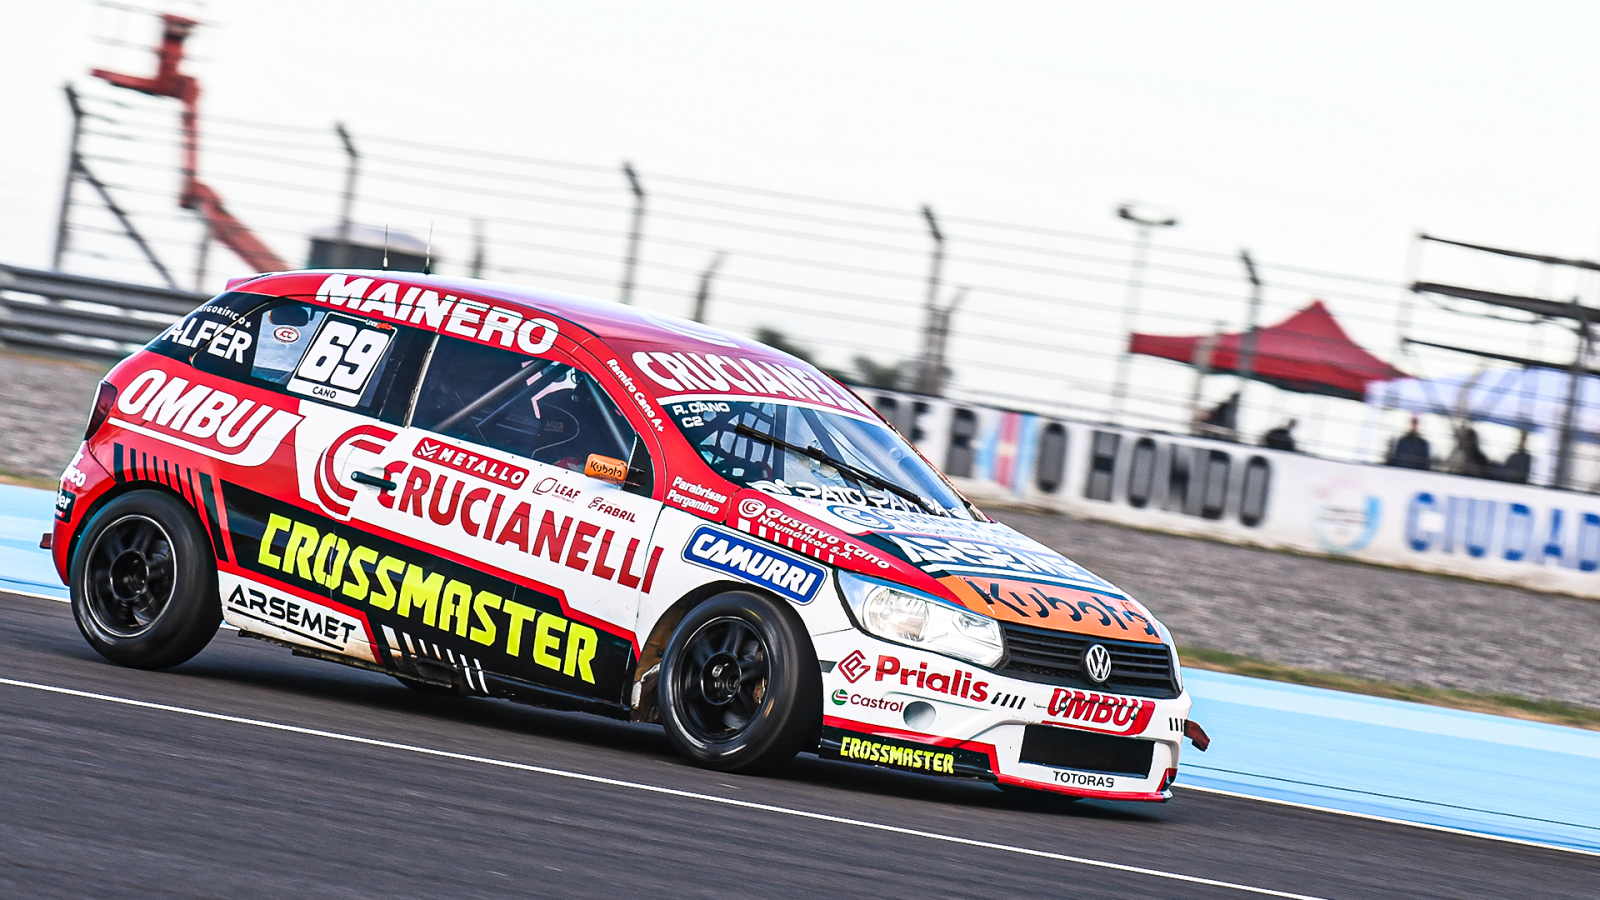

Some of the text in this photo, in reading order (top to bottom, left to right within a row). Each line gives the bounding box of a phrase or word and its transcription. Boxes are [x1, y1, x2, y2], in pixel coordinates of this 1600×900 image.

[314, 273, 560, 355] MAINERO
[161, 317, 253, 363] ALFER
[297, 319, 391, 391] 69
[117, 369, 273, 448] OMBU
[312, 386, 338, 399] CANO
[606, 358, 637, 393] Ramiro
[634, 391, 656, 418] Cano
[688, 402, 731, 413] CANO
[681, 416, 705, 428] C2
[438, 446, 526, 485] METALLO
[590, 461, 623, 477] Kubota
[1084, 429, 1272, 528] HONDO
[554, 483, 581, 499] LEAF
[597, 503, 636, 523] FABRIL
[666, 489, 720, 515] Pergamino
[672, 476, 728, 504] Parabrisas
[796, 481, 866, 508] PATO
[376, 459, 665, 595] CRUCIANELLI
[757, 515, 853, 561] Neumáticos S.A.
[764, 507, 890, 569] Gustavo Cano
[1405, 492, 1600, 572] CIUDAD
[691, 533, 818, 597] CAMURRI
[227, 584, 356, 643] ARSEMET
[257, 512, 599, 685] CROSSMASTER
[964, 576, 1160, 639] Kubota
[875, 654, 989, 702] Prialis
[850, 693, 905, 713] Castrol
[1047, 688, 1143, 726] OMBU
[840, 736, 955, 774] CROSSMASTER
[1053, 771, 1115, 788] TOTORAS
